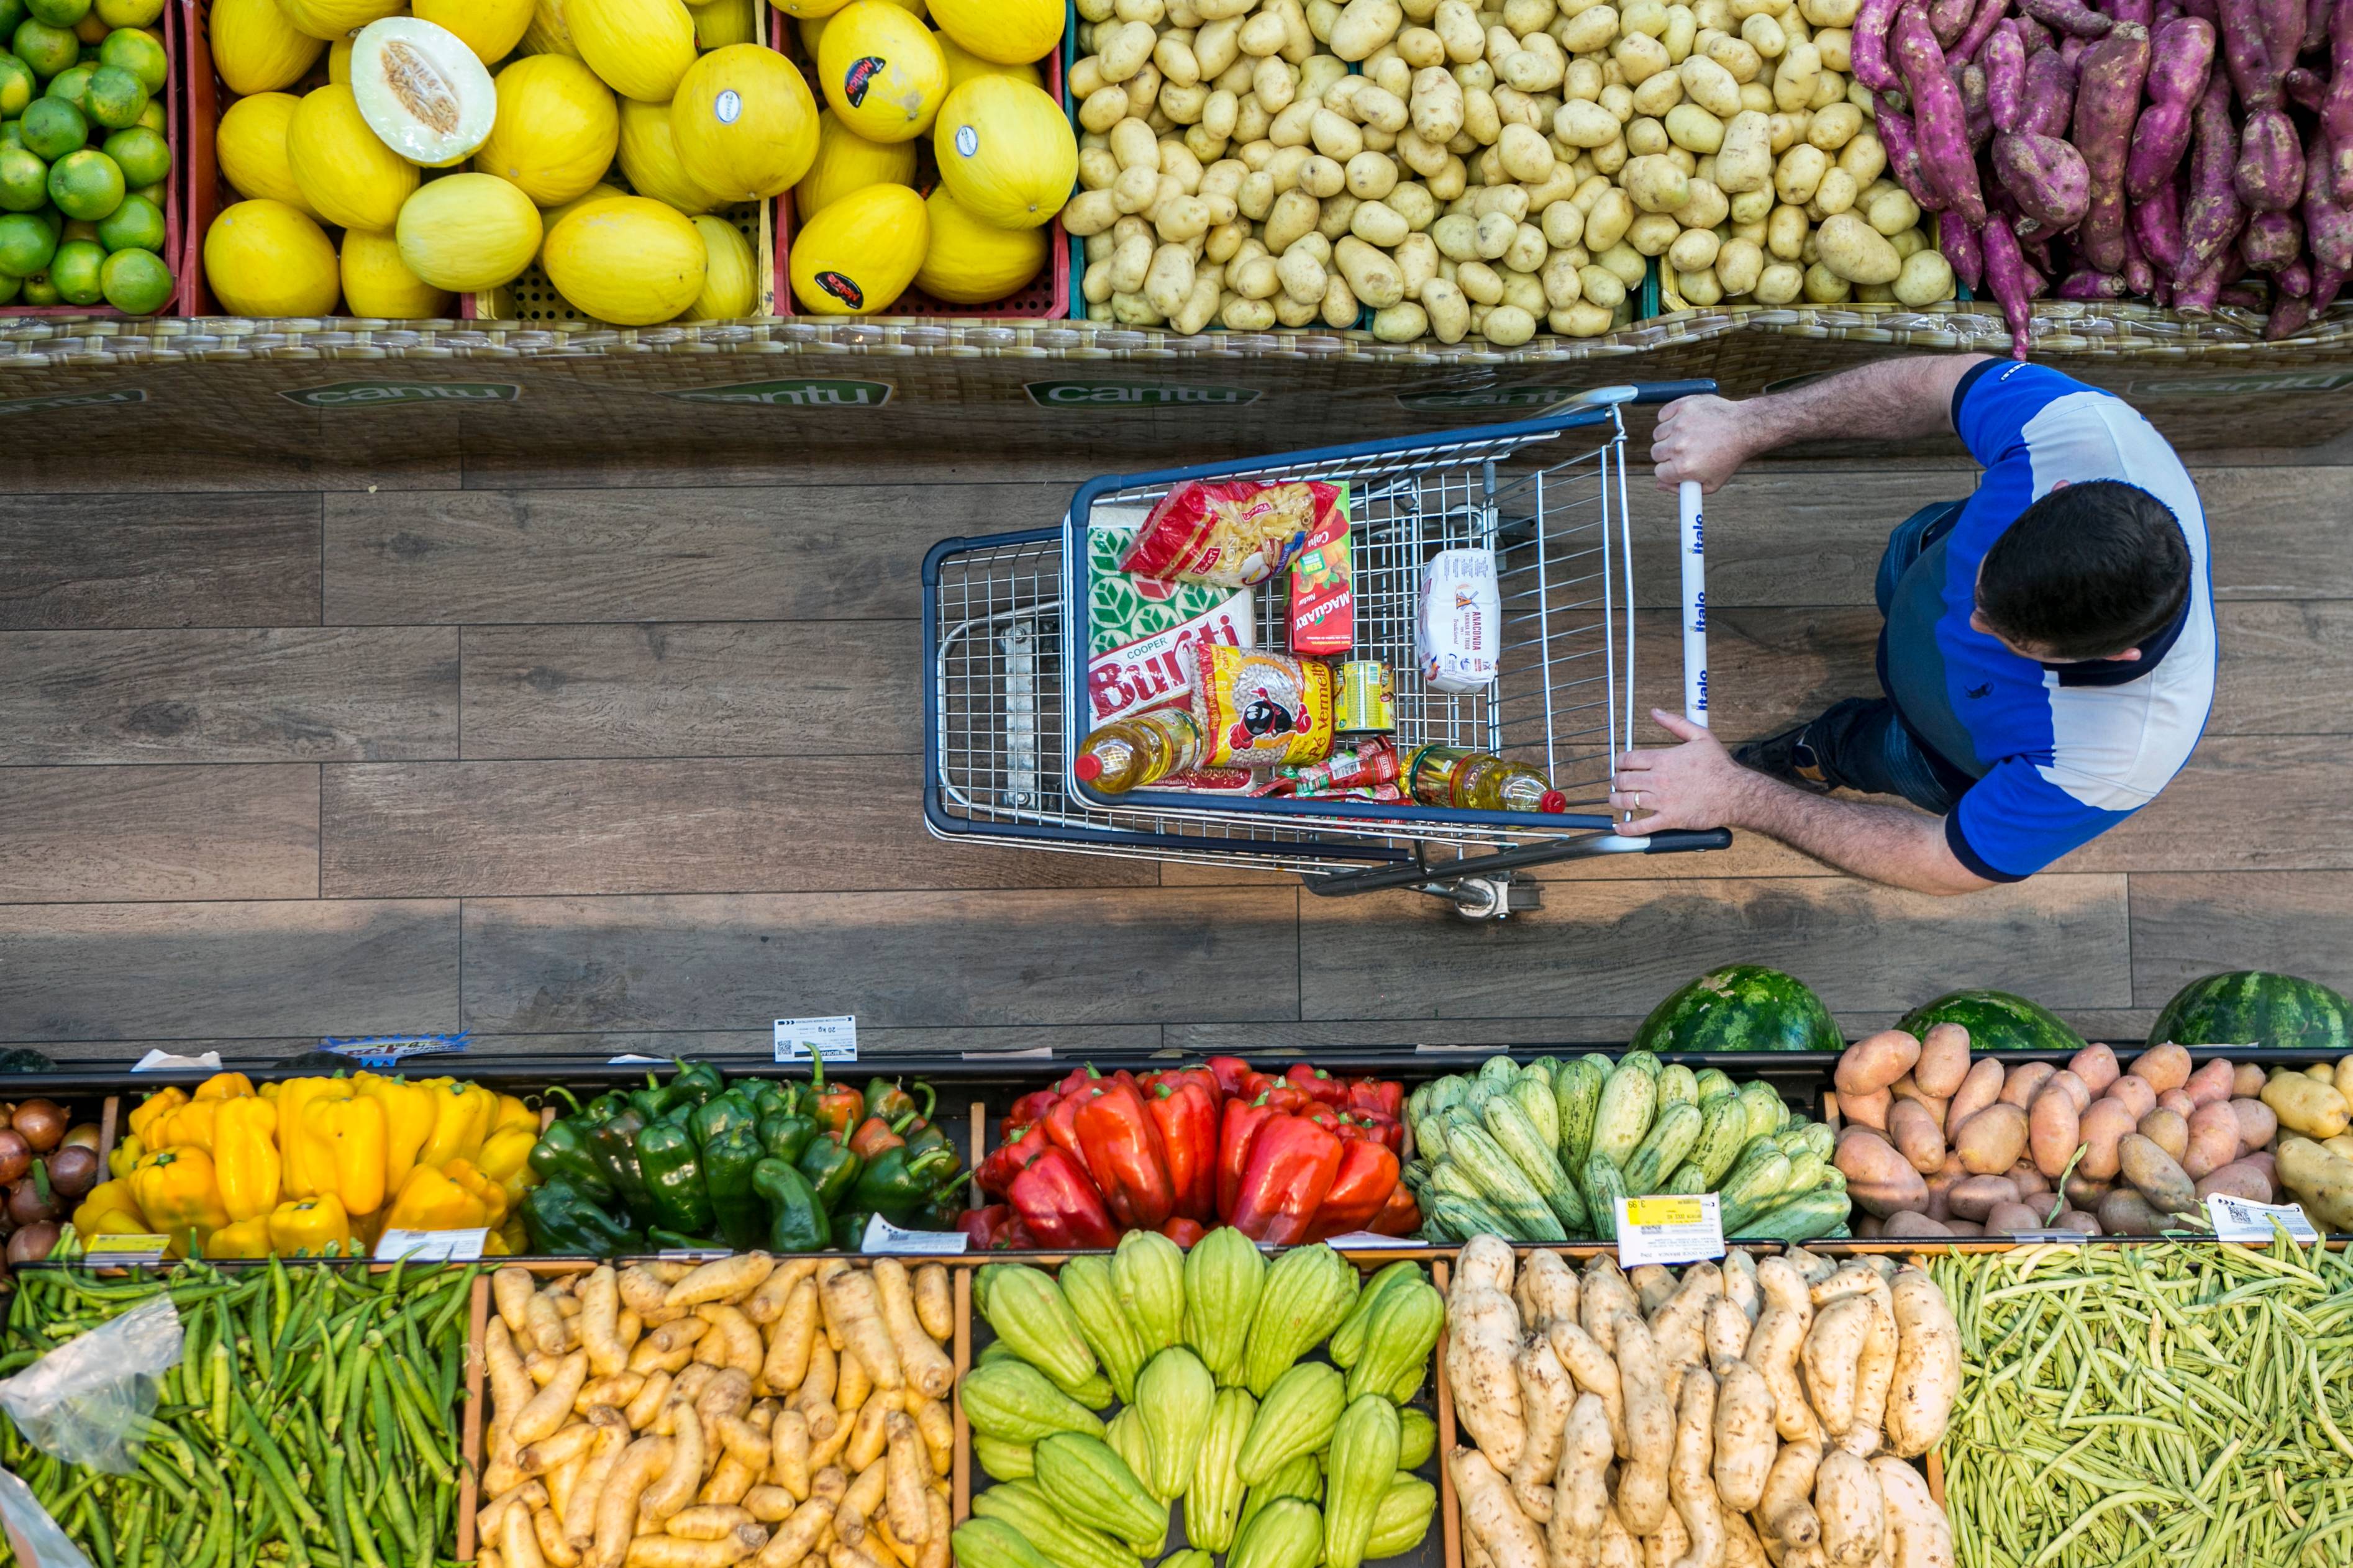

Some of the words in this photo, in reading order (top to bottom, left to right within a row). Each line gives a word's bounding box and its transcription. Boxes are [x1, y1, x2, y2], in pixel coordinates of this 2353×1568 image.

[2147, 376, 2341, 391] cantu
[307, 384, 500, 404] cantu
[1049, 386, 1237, 403] cantu
[1417, 389, 1572, 406] cant
[1308, 530, 1330, 547] Caju
[1196, 550, 1219, 574] Parati
[1306, 564, 1322, 573] SEM
[1473, 612, 1481, 651] ANACONDA
[1127, 637, 1168, 659] COOPER
[1205, 673, 1216, 707] Premium
[1313, 661, 1329, 731] Vermelh
[1308, 737, 1326, 757] Pé
[1628, 1200, 1646, 1208] 3.99
